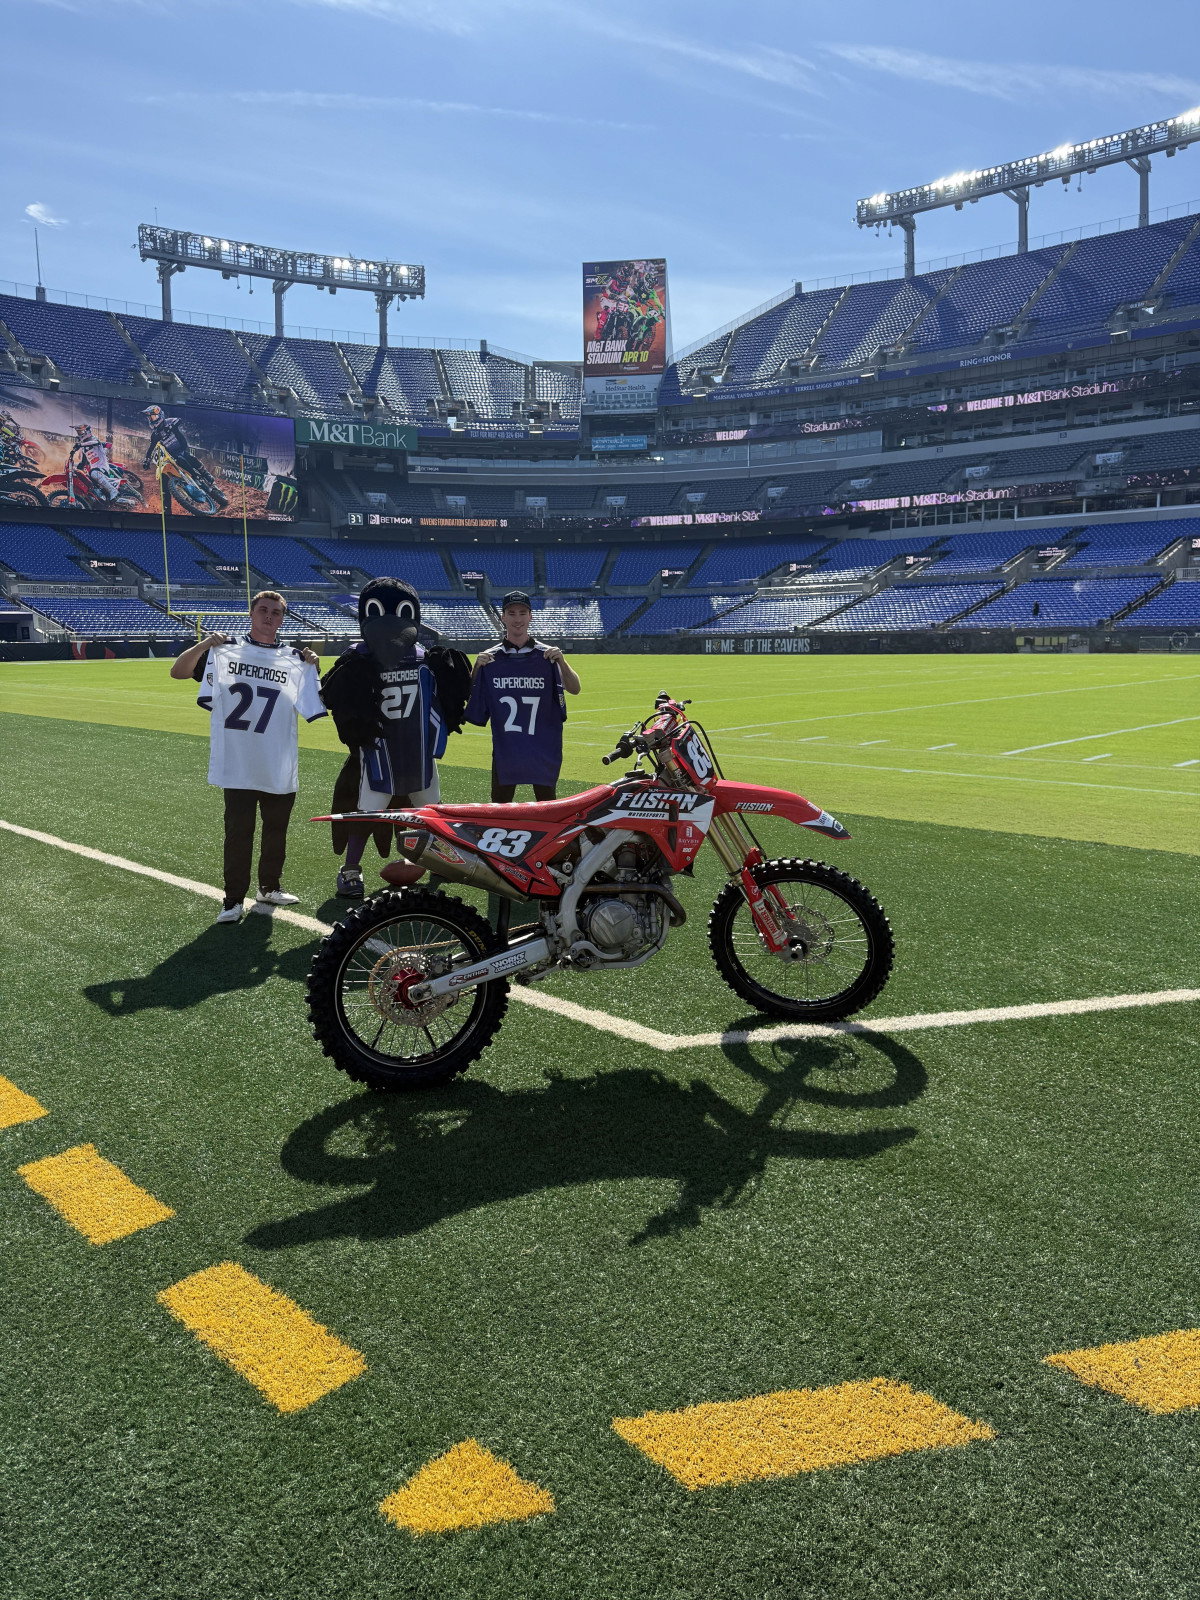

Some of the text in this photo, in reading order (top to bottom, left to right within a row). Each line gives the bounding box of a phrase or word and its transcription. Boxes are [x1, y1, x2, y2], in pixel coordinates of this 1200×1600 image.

[586, 340, 628, 352] M&T BANK
[586, 350, 649, 364] STADIUM APR 10
[960, 358, 978, 367] RING
[982, 352, 1012, 364] HONOR
[966, 382, 1116, 411] WELCOME TO M&T Bank Stadium
[308, 420, 407, 448] M&T Bank
[804, 420, 840, 433] Stadium
[865, 488, 1009, 511] WELCOME TO M&T Bank Stadium
[500, 519, 507, 527] $0
[650, 515, 682, 526] WELCOME
[684, 515, 692, 524] TO
[695, 513, 719, 524] M&T
[719, 512, 741, 522] Bank
[744, 639, 754, 652] OF
[756, 639, 772, 652] THE
[775, 638, 810, 653] RAVENS
[228, 662, 288, 684] SUPERCROSS
[493, 678, 544, 689] SUPERCROSS
[224, 682, 280, 734] 27
[381, 684, 418, 720] 27
[499, 696, 540, 736] 27
[687, 734, 712, 778] 83
[616, 793, 698, 811] FUSION
[735, 802, 773, 811] FUSION
[477, 828, 532, 858] 83
[492, 951, 526, 968] WORKS
